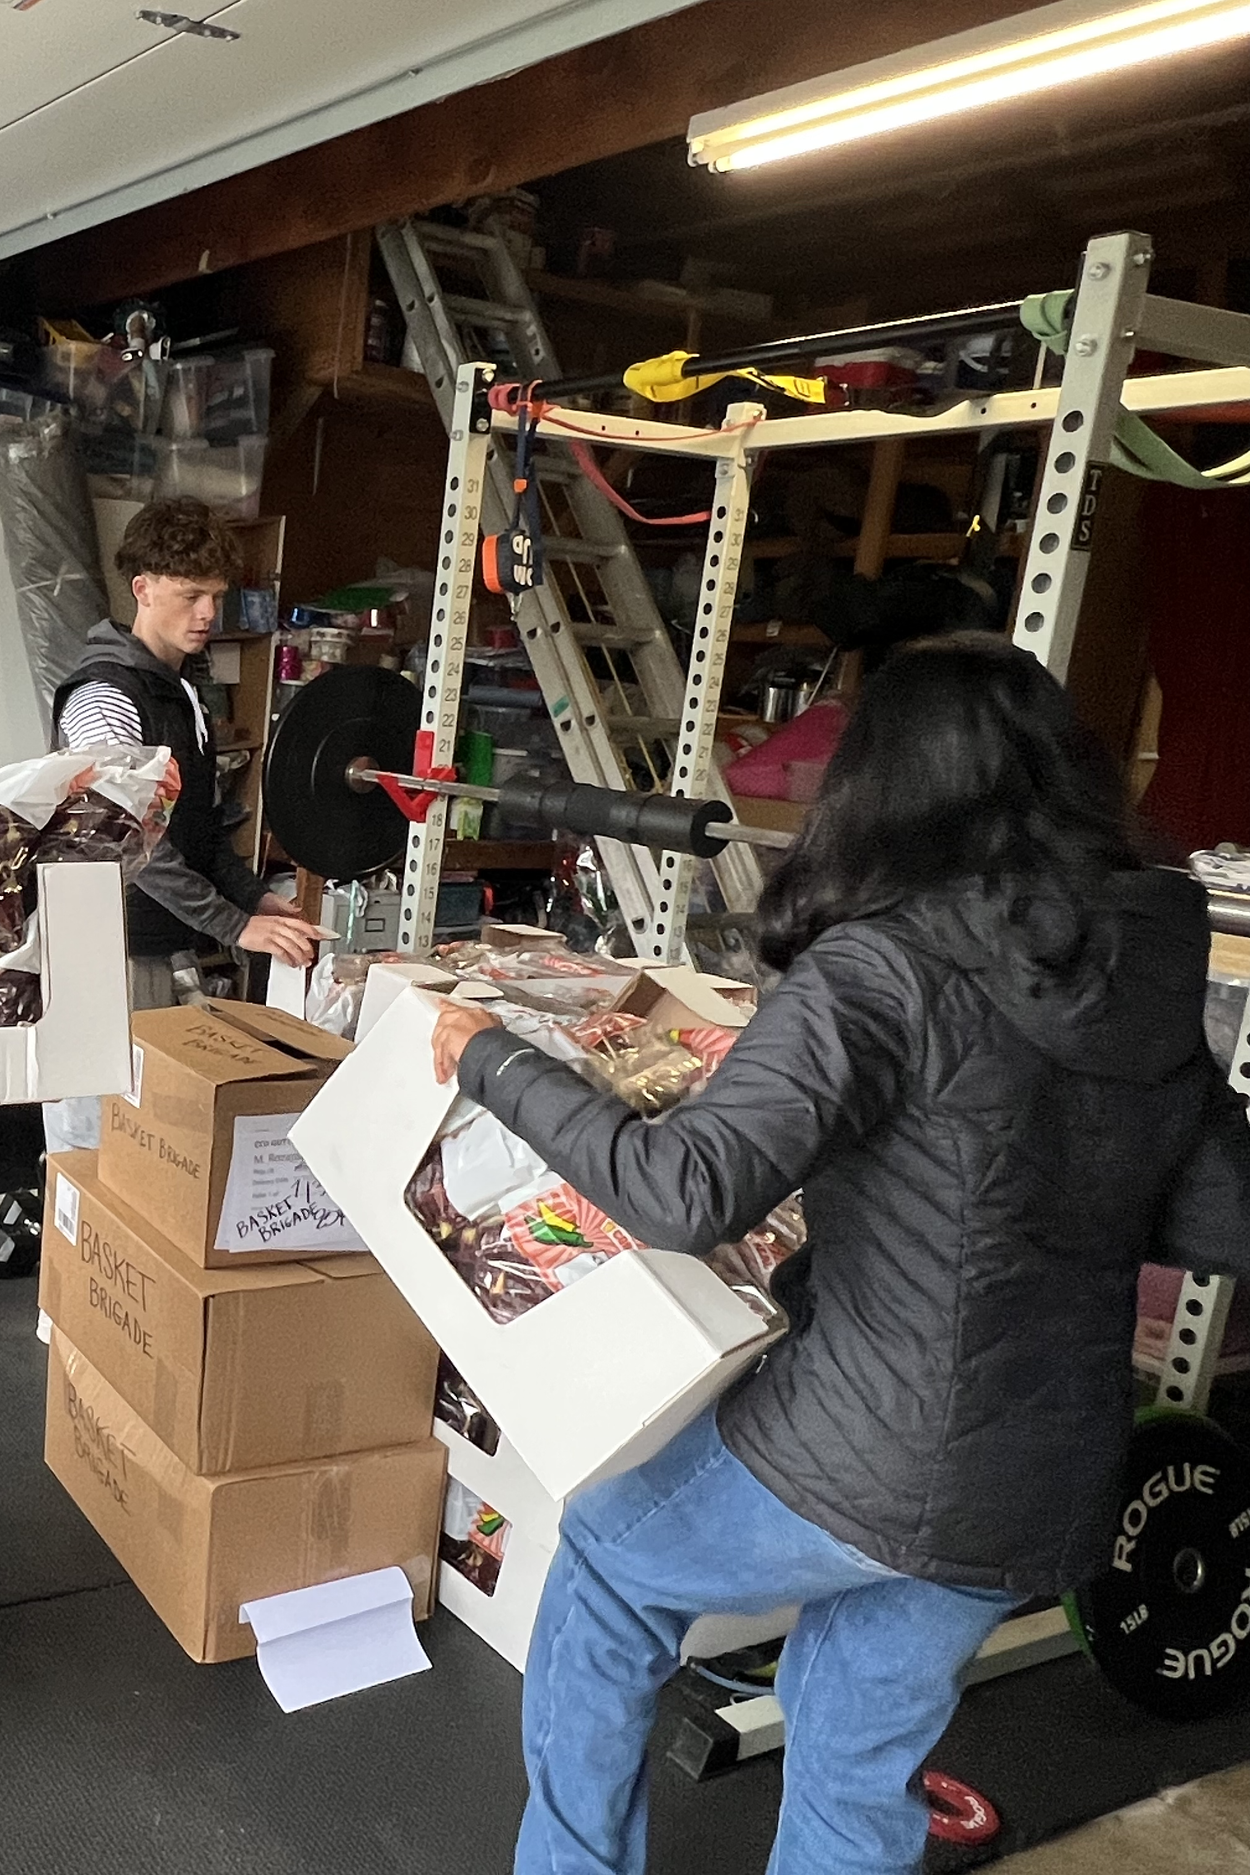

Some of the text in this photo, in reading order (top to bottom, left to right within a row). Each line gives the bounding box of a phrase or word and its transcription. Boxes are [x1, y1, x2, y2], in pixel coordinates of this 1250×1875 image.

[467, 479, 479, 494] 31
[1078, 468, 1103, 542] TDS
[464, 506, 477, 520] 30
[461, 532, 474, 546] 29
[459, 559, 471, 573] 28
[456, 585, 469, 599] 27
[453, 611, 466, 625] 26
[450, 637, 463, 650] 25
[447, 662, 460, 676] 24
[444, 688, 457, 702] 23
[442, 714, 455, 727] 22
[439, 739, 451, 752] 21
[432, 813, 443, 827] 18
[429, 838, 440, 851] 17
[426, 863, 437, 875] 16
[423, 887, 434, 900] 15
[421, 911, 431, 924] 14
[418, 935, 429, 948] 13
[111, 1102, 201, 1180] BASKET BRIGADE
[236, 1196, 294, 1238] BASKET
[258, 1202, 318, 1243] BRIGADE
[80, 1220, 156, 1313] BASKET
[89, 1276, 154, 1359] BRIGADE
[66, 1382, 136, 1480] BASKET
[1112, 1462, 1221, 1573] ROGUE
[1120, 1603, 1149, 1635] 15LB
